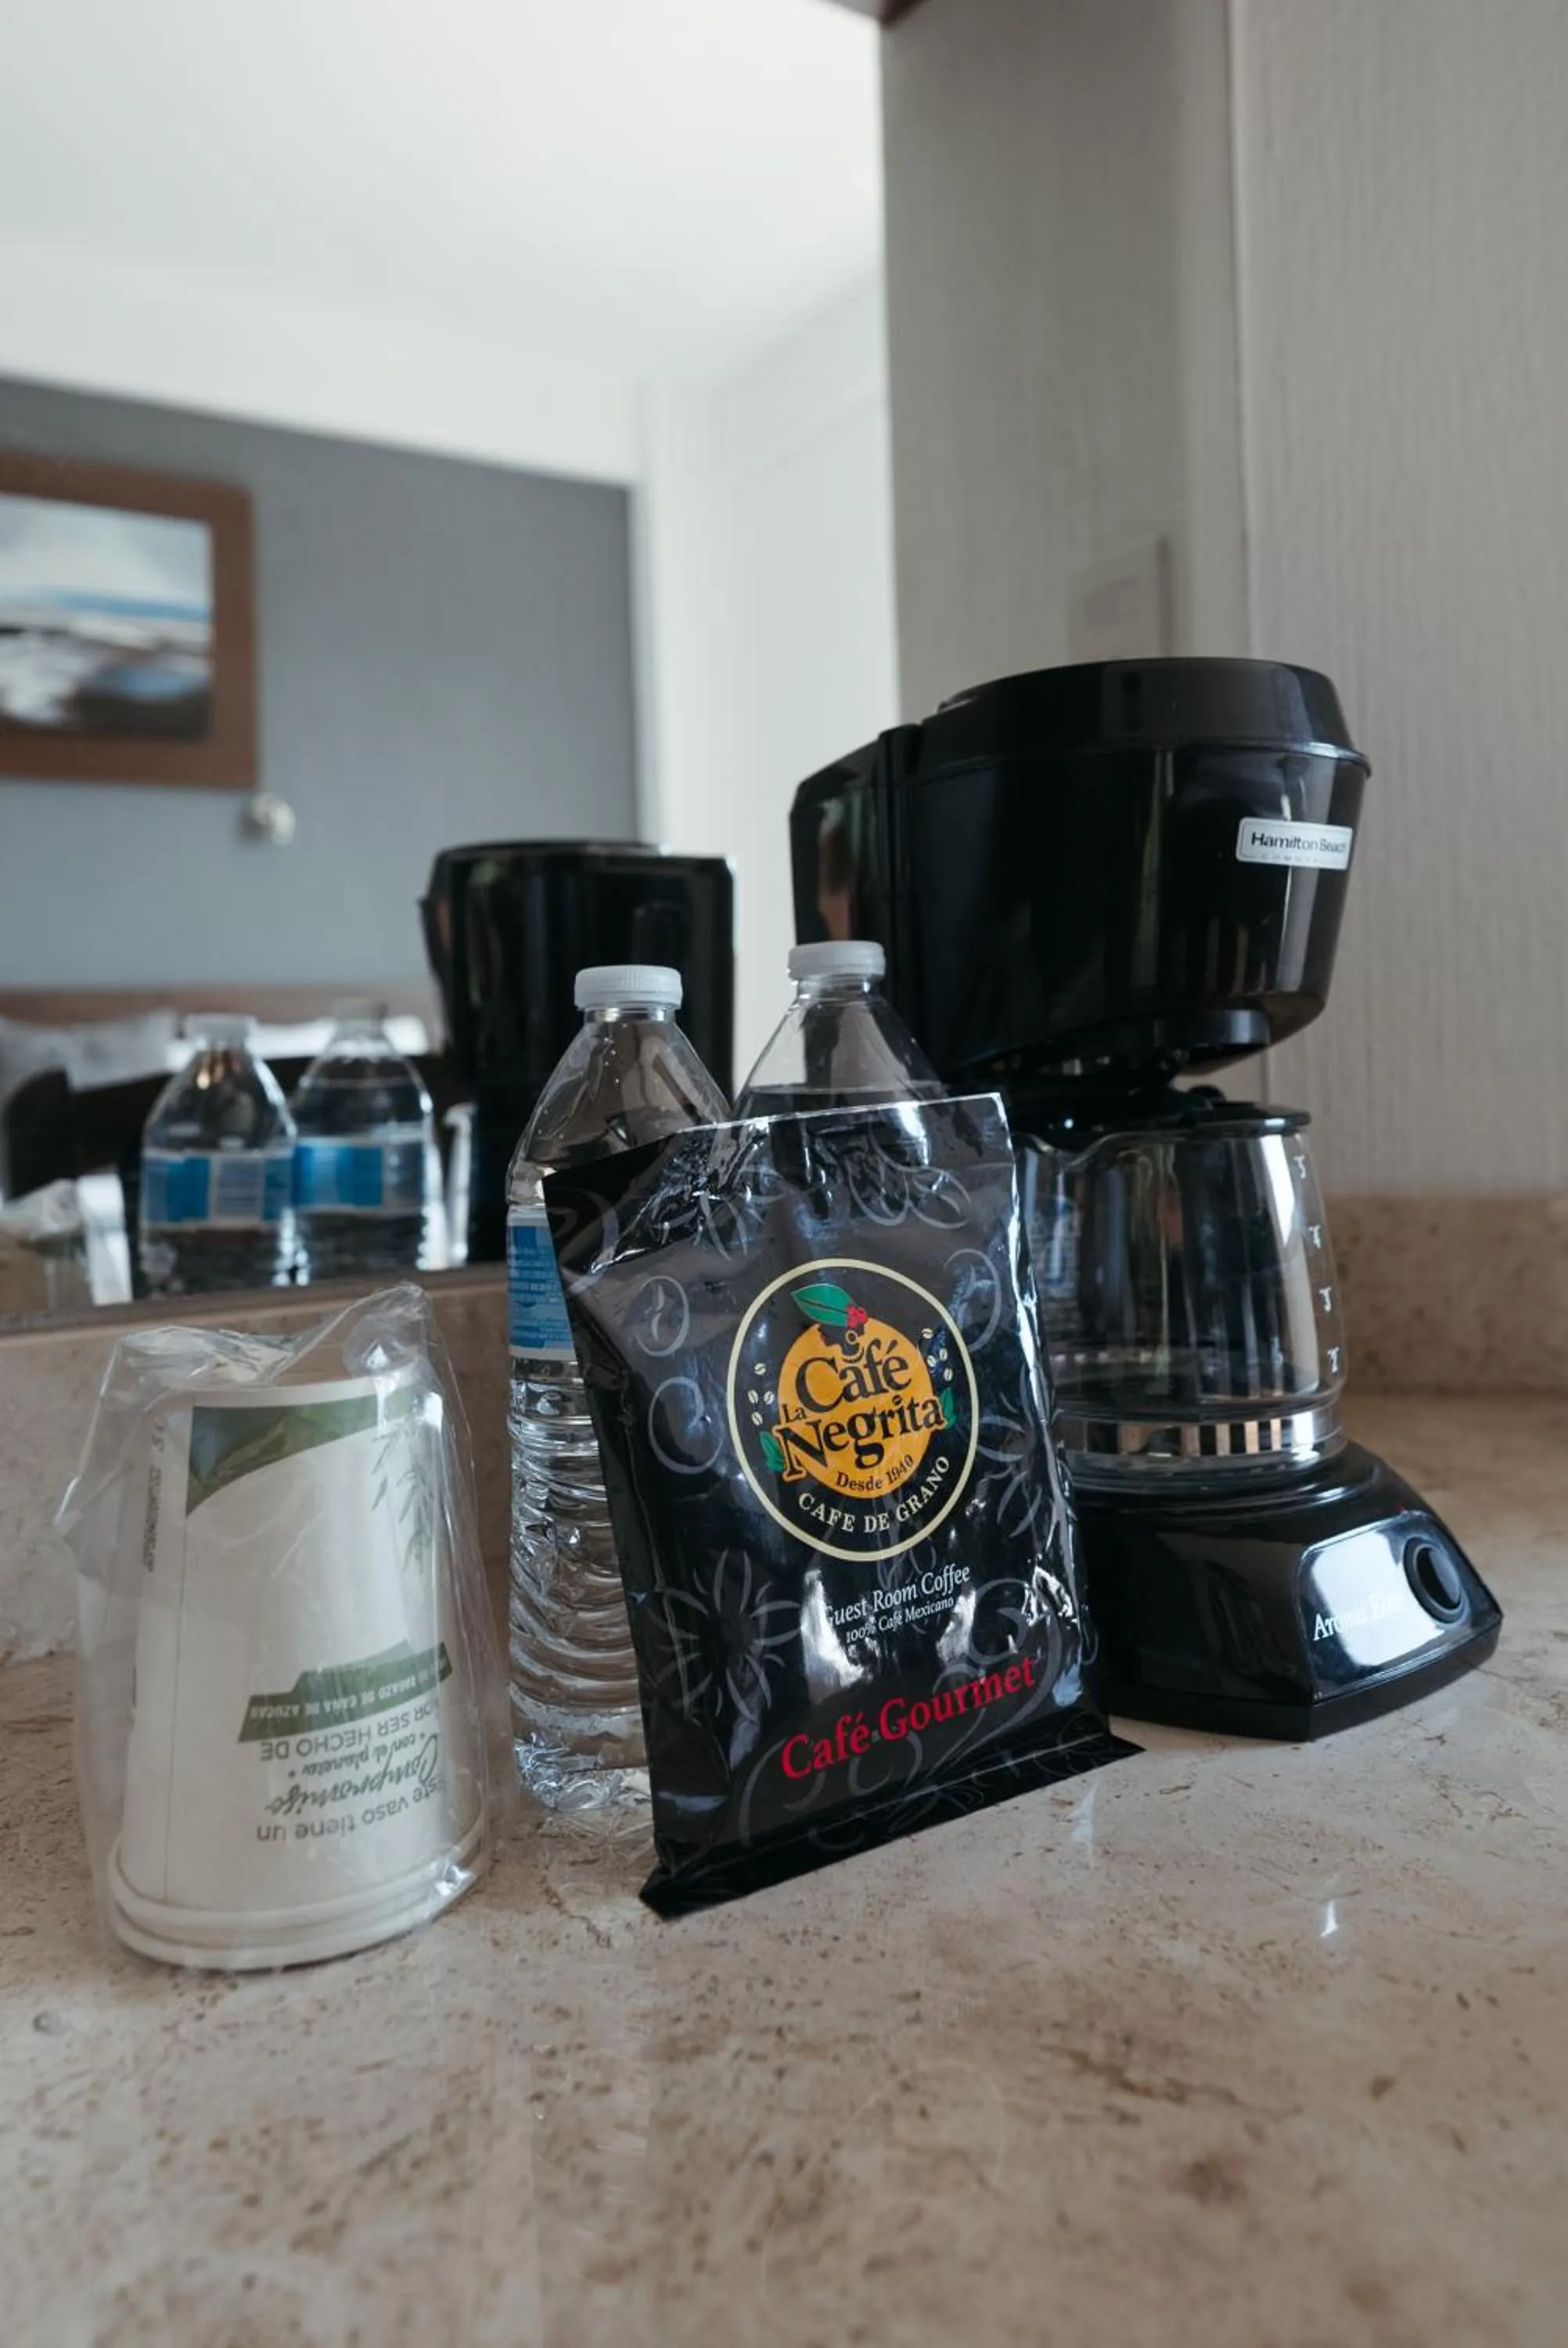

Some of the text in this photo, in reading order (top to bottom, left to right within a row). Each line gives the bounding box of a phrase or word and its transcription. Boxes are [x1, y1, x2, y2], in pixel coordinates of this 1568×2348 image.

[1251, 832, 1318, 851] Hamilton
[794, 1338, 912, 1413] Café
[783, 1404, 807, 1423] La
[775, 1394, 945, 1478] Negrita
[835, 1453, 915, 1492] Desde 1940
[798, 1456, 951, 1534] CAFE DE GRANO
[872, 1583, 918, 1613] Room
[921, 1564, 970, 1597] Coffee
[846, 1597, 955, 1644] 100% Café Mexicano
[377, 1714, 411, 1736] SER
[781, 1655, 1035, 1779] Café Gourmet
[260, 1741, 290, 1762] DE
[295, 1730, 372, 1757] HECHO
[362, 1795, 409, 1825] vaso
[257, 1824, 286, 1842] un
[295, 1814, 356, 1840] tiene
